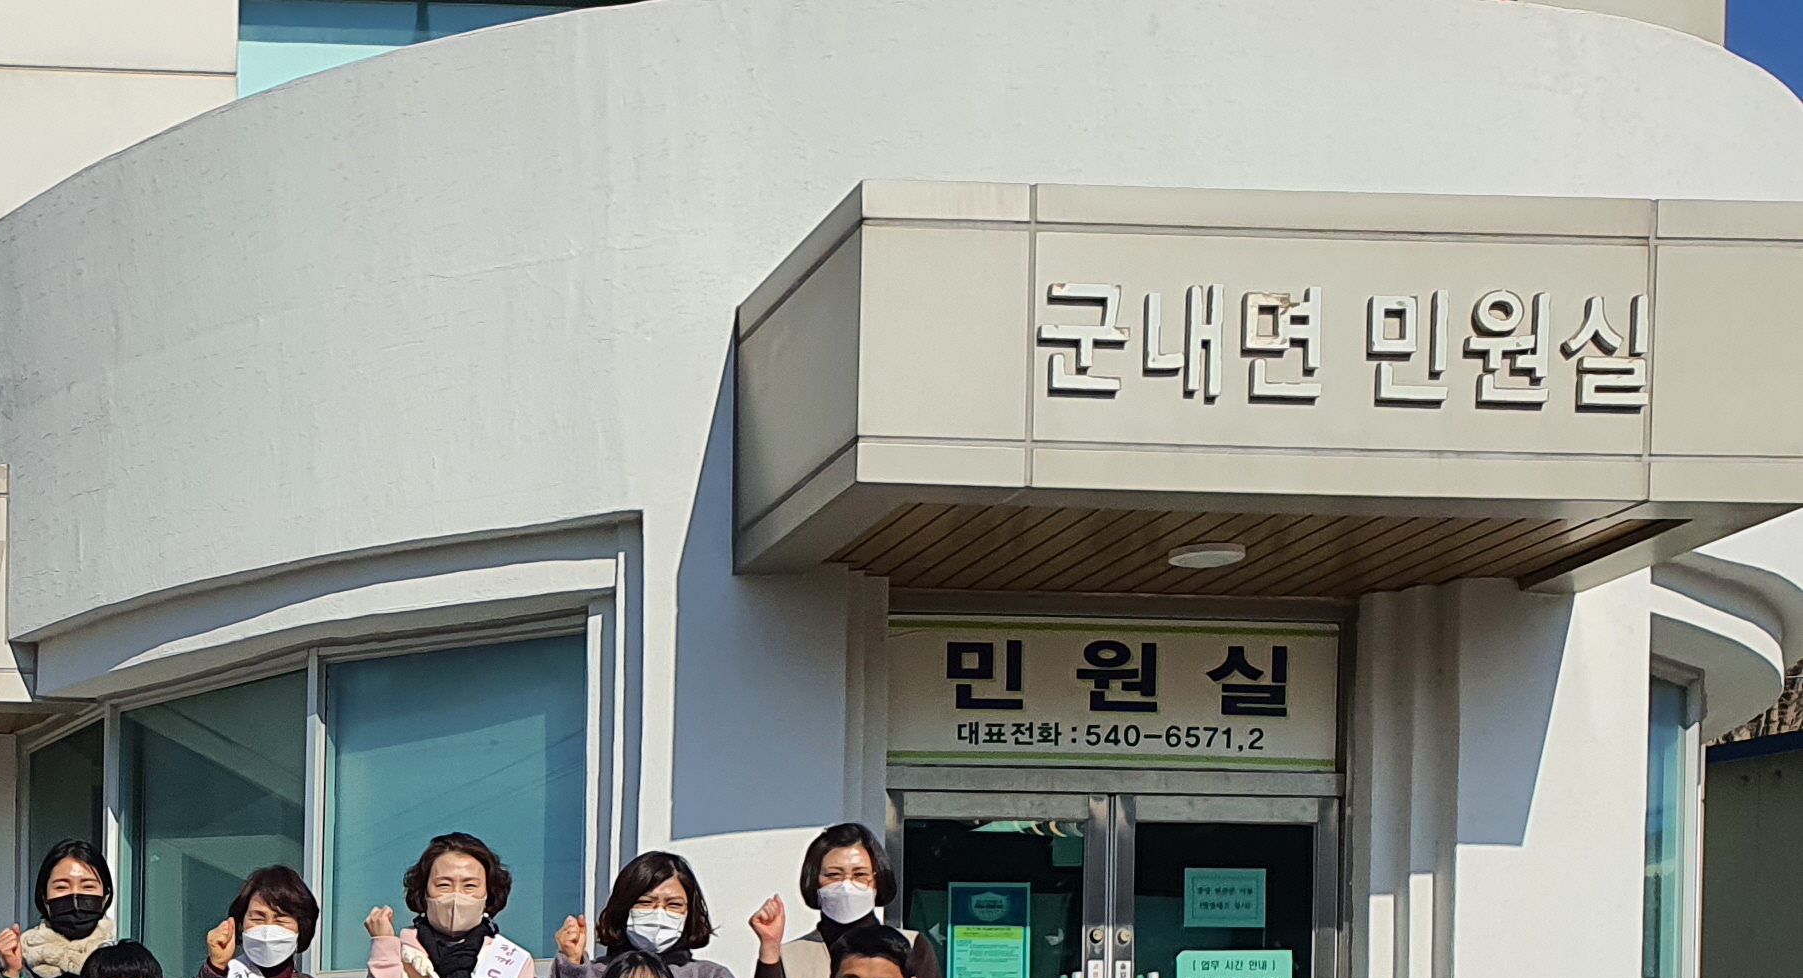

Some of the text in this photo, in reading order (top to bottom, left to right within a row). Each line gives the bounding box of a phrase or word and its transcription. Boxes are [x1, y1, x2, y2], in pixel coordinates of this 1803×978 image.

[1038, 282, 1648, 412] 군내면 민원실
[1225, 961, 1244, 971] 시간
[1248, 961, 1268, 971] 안내
